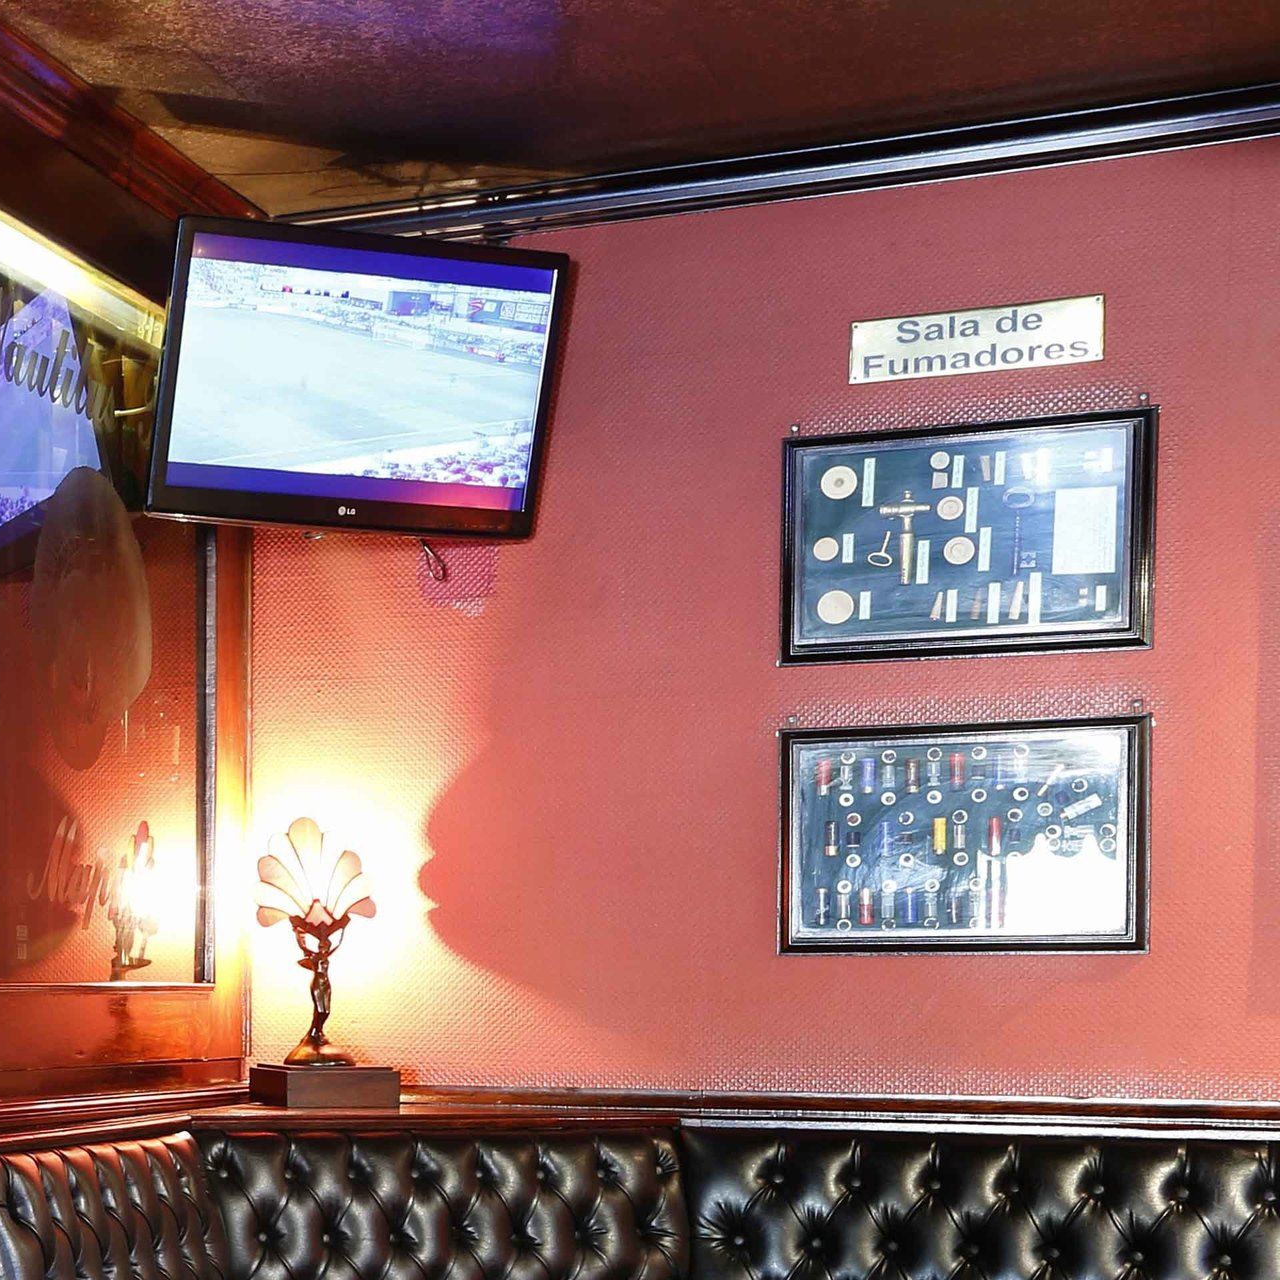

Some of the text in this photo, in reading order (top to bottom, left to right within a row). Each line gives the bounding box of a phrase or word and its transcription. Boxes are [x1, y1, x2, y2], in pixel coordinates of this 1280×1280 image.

[896, 309, 1044, 345] Sala de
[862, 340, 1090, 379] Fumadores
